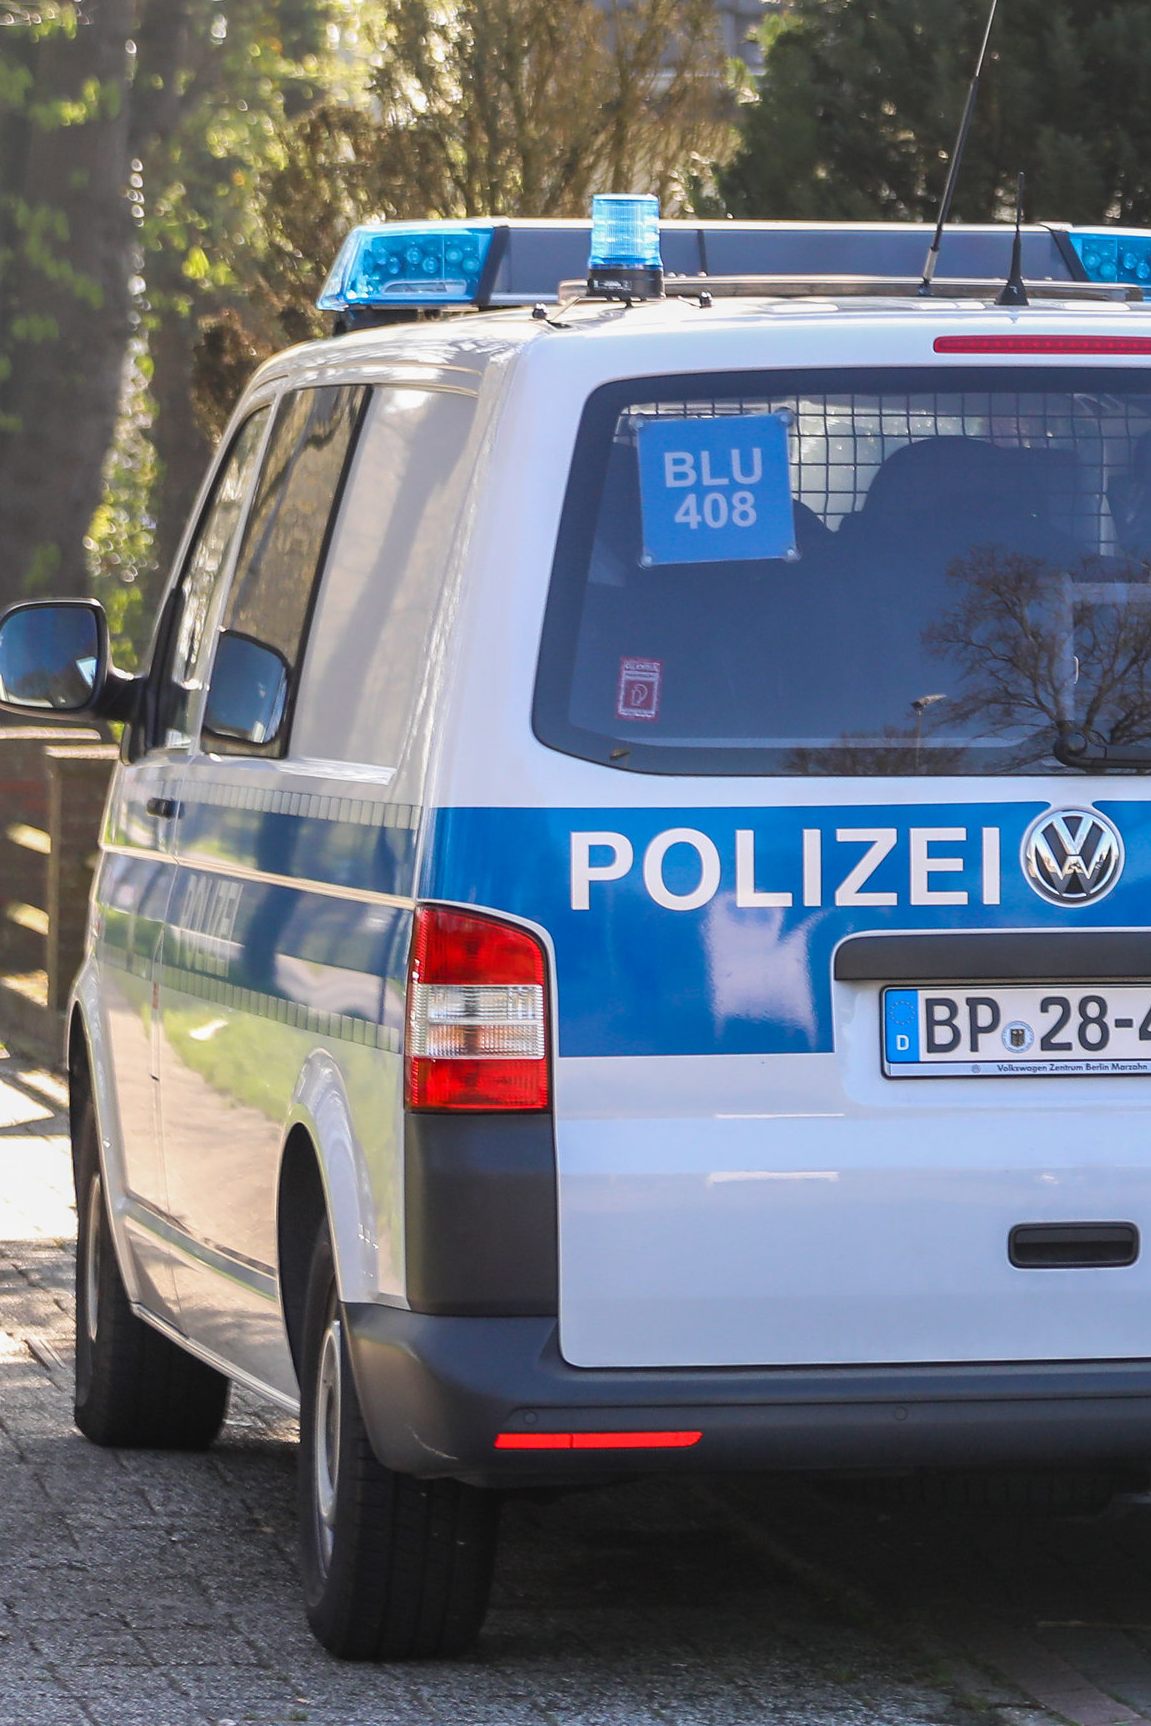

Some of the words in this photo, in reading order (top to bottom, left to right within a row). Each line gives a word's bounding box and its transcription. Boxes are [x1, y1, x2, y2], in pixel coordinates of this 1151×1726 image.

[665, 447, 763, 489] BLU
[673, 492, 758, 530] 408
[568, 828, 1002, 911] POLIZEI
[1024, 808, 1122, 904] VW
[895, 1035, 911, 1052] D
[925, 997, 1001, 1054] BP
[997, 1064, 1048, 1073] Volkswagen
[1050, 1063, 1085, 1071] Zentrum
[1085, 1063, 1110, 1071] Berlin
[1111, 1062, 1149, 1070] Marzahn
